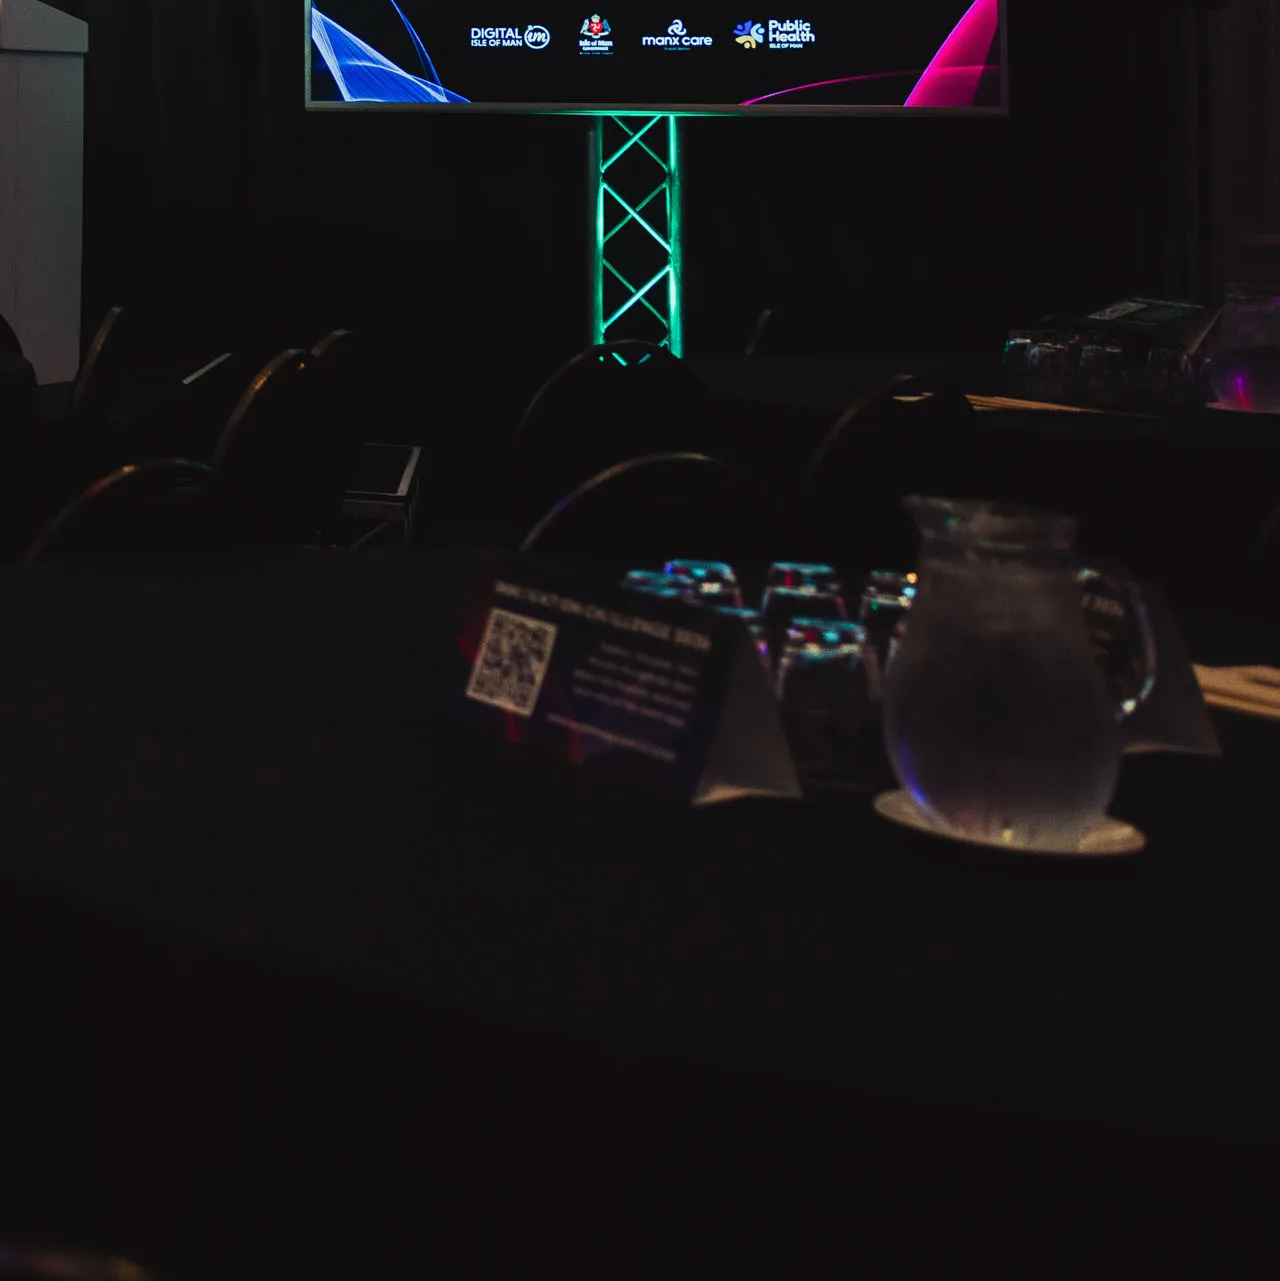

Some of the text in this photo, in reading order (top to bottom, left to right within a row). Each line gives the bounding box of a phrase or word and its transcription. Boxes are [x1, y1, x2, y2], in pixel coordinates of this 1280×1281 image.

[768, 20, 811, 32] Public
[471, 28, 522, 39] DIGITAL
[768, 30, 815, 42] Health
[643, 37, 712, 45] manx care
